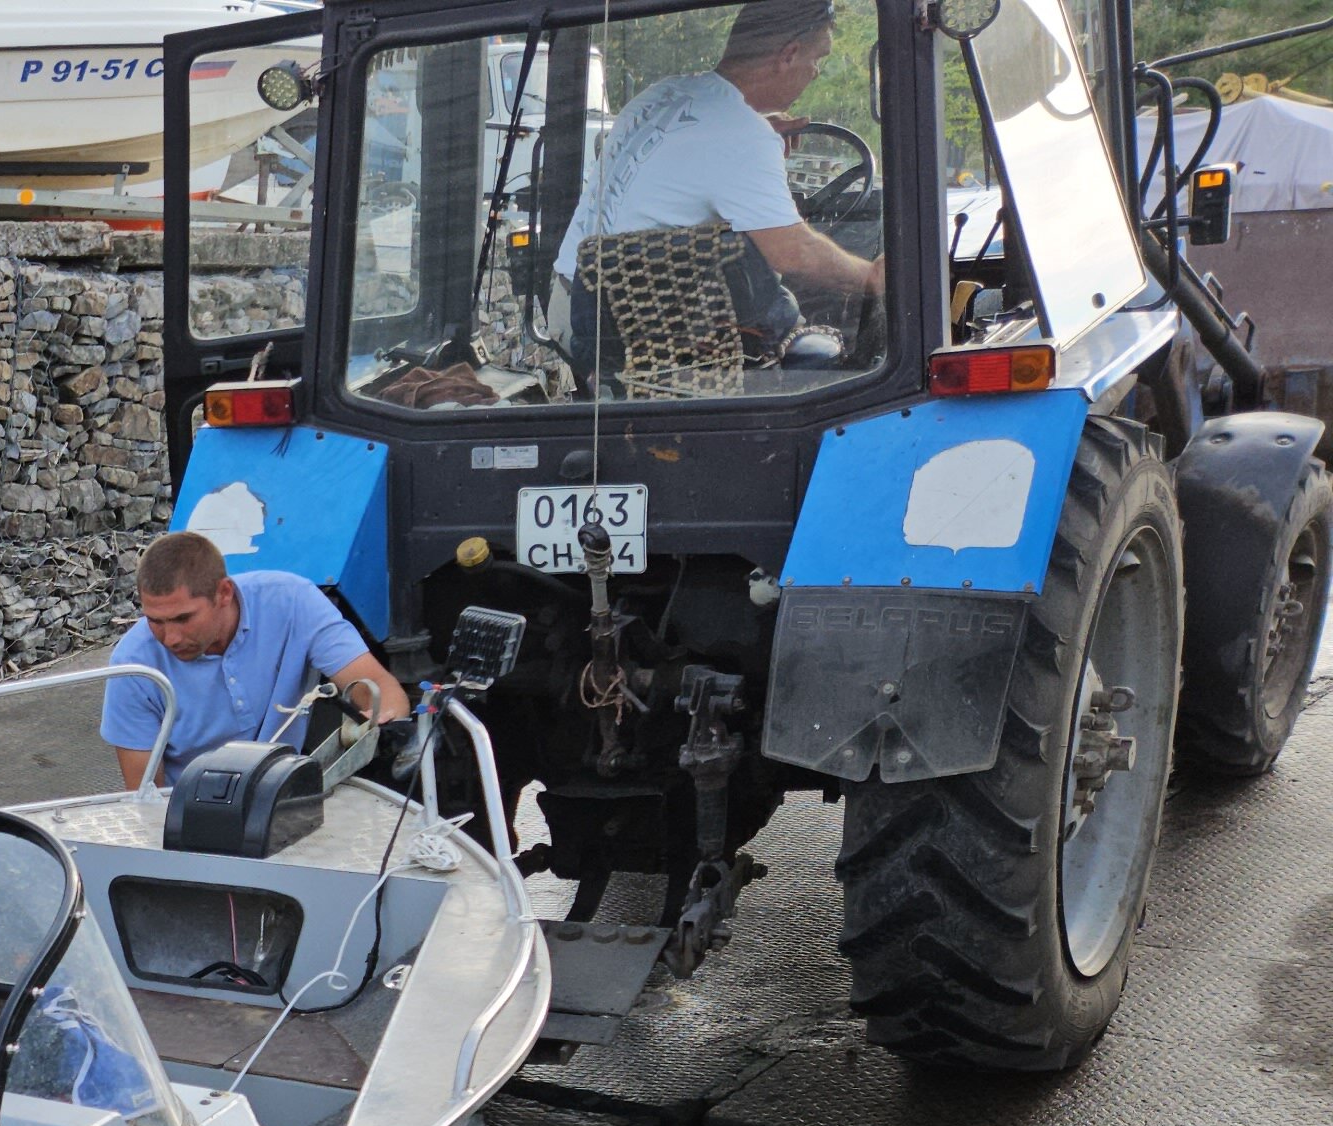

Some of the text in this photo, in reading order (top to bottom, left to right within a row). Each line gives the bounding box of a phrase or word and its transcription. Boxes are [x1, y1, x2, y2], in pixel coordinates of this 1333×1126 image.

[51, 59, 140, 83] 91-51
[534, 493, 630, 529] 0163
[790, 605, 1014, 636] BELARUS
